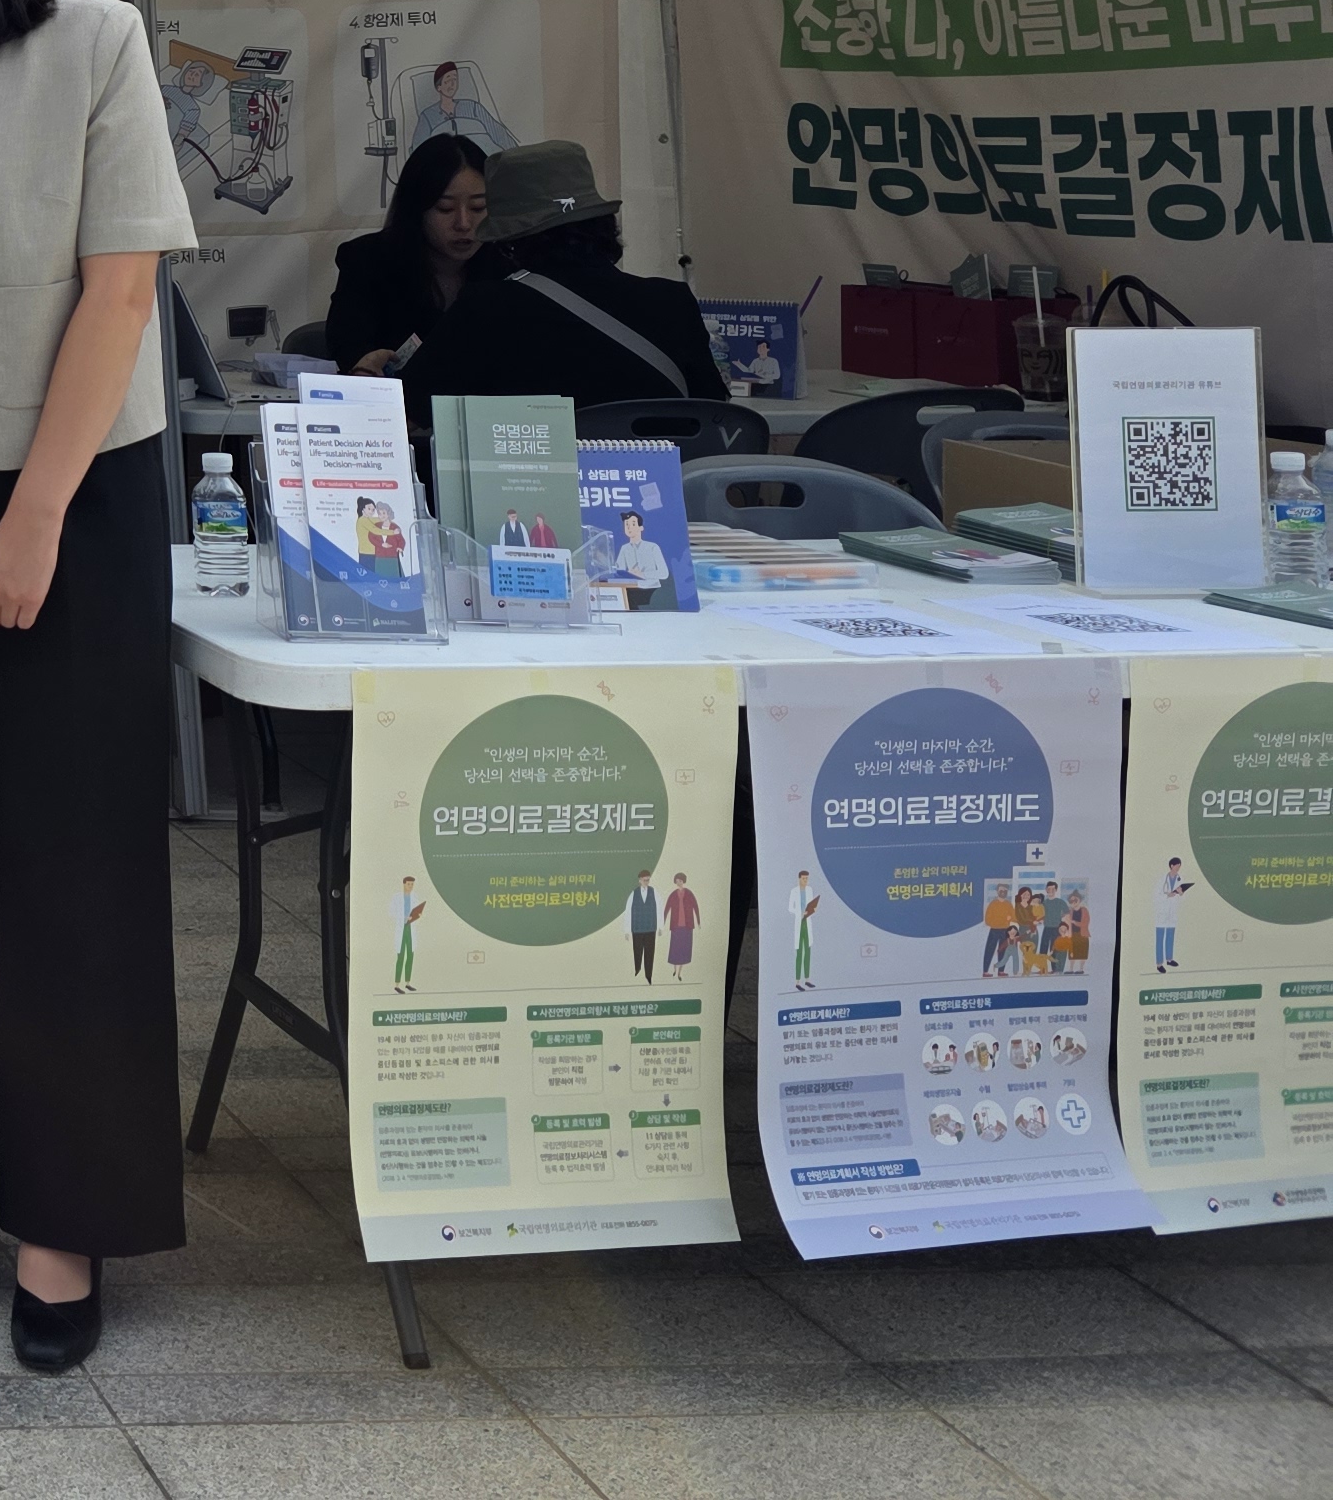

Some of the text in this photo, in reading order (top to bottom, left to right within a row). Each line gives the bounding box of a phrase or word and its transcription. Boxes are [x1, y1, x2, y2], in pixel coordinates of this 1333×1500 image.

[363, 12, 404, 30] 항암제
[406, 10, 437, 28] 투여
[787, 101, 1333, 244] 연명의료결정제
[492, 423, 551, 439] 연명의료
[309, 438, 393, 449] Patient Decision Aids for
[493, 440, 552, 456] 결정제도
[309, 449, 395, 460] Life-sustaining Treatment
[323, 460, 383, 470] Decision-making
[587, 468, 648, 482] 상담을 위한
[533, 745, 574, 762] 마지막
[576, 745, 608, 763] 순간,
[921, 738, 962, 754] 마지막
[964, 737, 996, 755] 순간,
[1233, 751, 1313, 769] 당신의 선택을
[823, 792, 1041, 828] 연명의료결정제도
[432, 802, 656, 837] 연명의료결정제도
[483, 891, 600, 908] 사전연명의료의향서
[886, 881, 973, 901] 연명의료계획서
